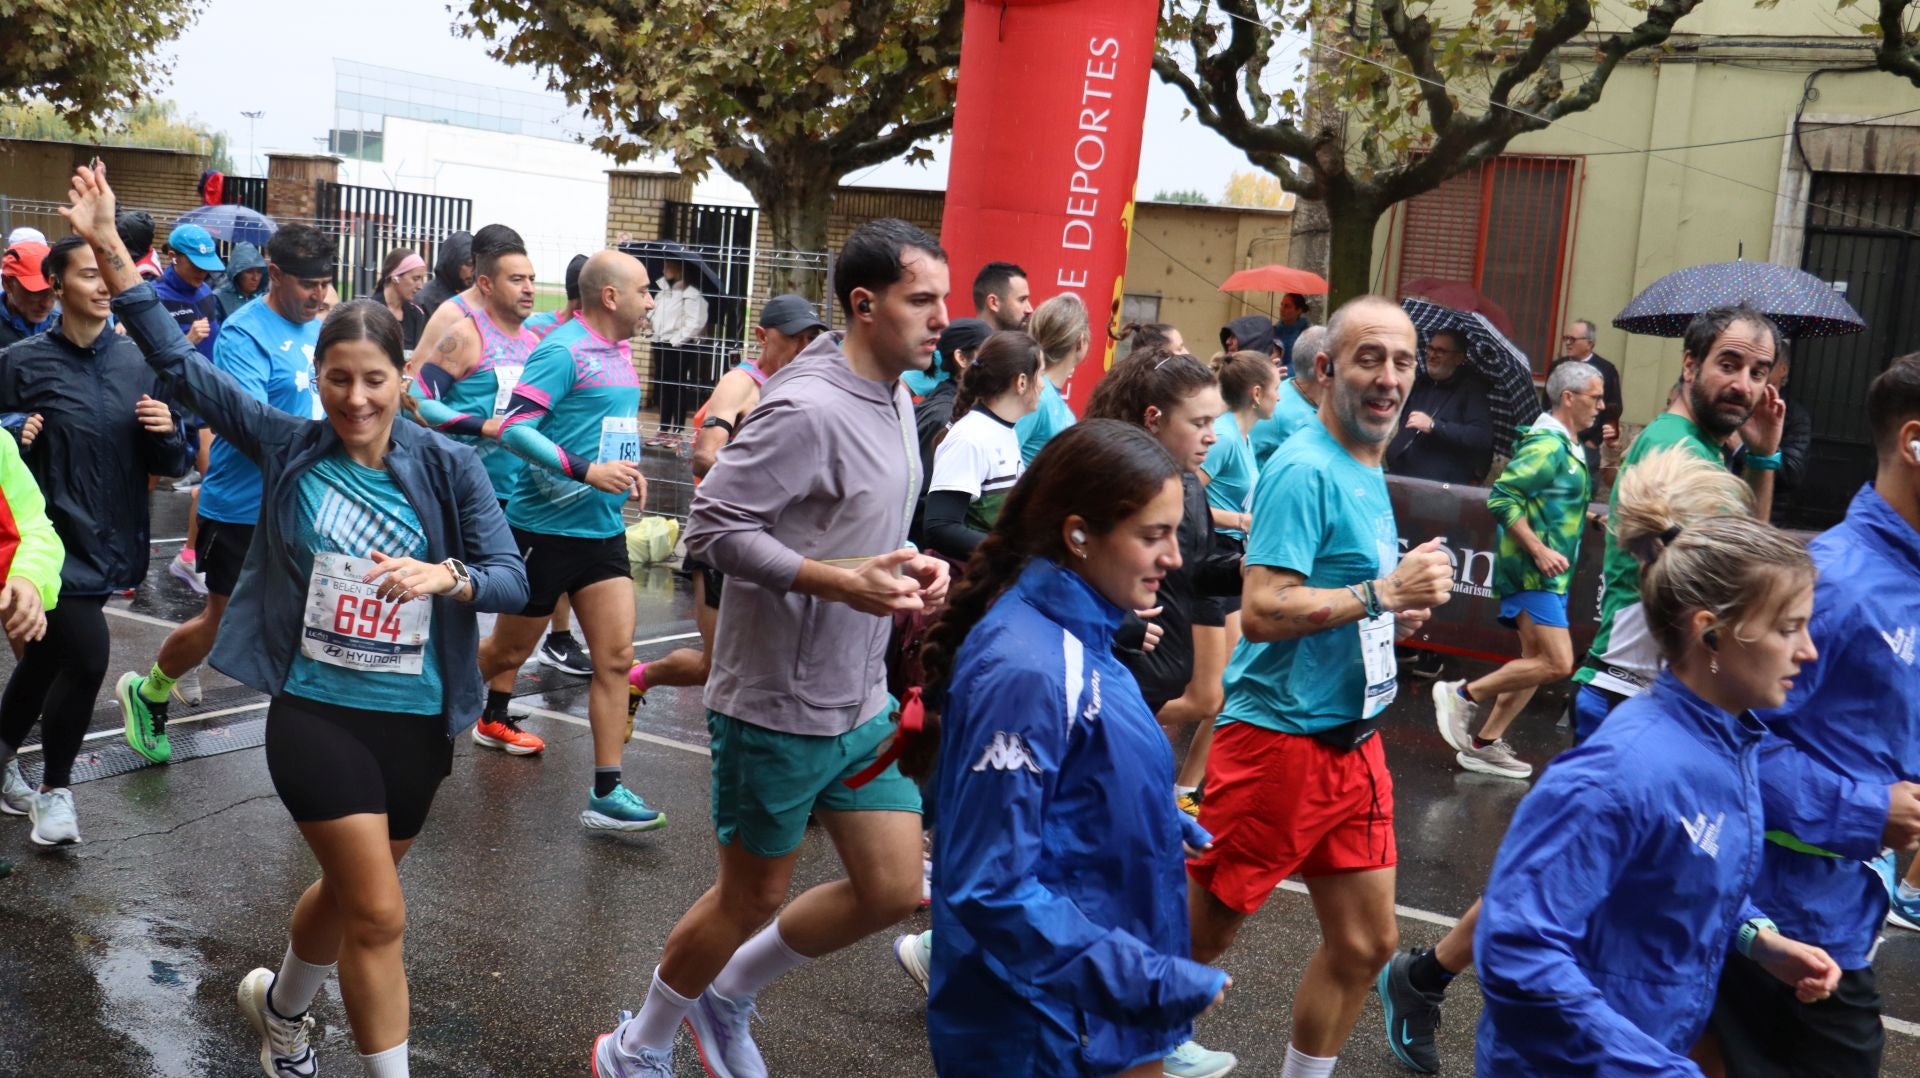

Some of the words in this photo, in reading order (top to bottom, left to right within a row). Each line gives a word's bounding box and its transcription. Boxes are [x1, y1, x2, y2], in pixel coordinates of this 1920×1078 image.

[1062, 37, 1119, 251] DEPORTES
[1057, 268, 1088, 301] E
[1453, 583, 1492, 598] ntarism
[334, 594, 401, 643] 694
[346, 651, 402, 664] HYUNDAI
